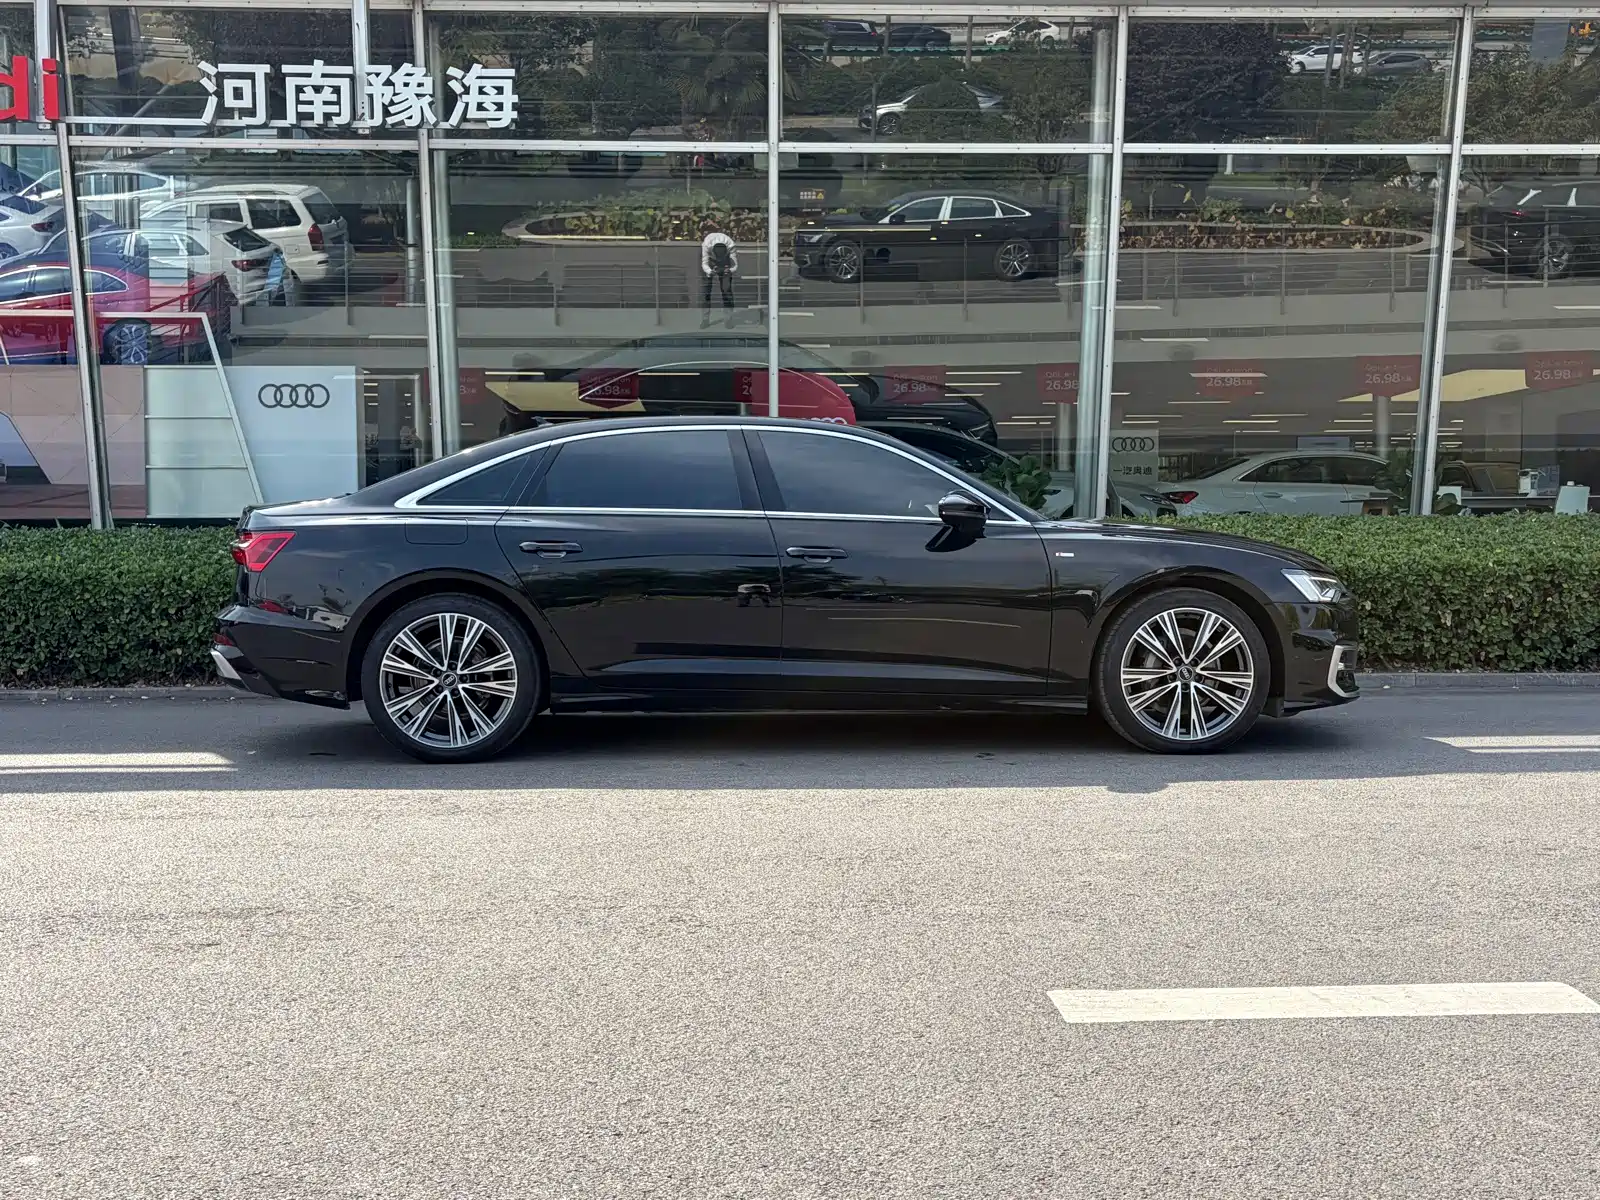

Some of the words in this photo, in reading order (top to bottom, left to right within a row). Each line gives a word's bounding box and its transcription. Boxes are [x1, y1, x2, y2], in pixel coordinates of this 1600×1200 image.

[197, 59, 519, 128] 河南豫海
[1365, 373, 1401, 384] 26.98
[1534, 369, 1571, 380] 26.98
[1113, 465, 1152, 476] 一汽奥迪
